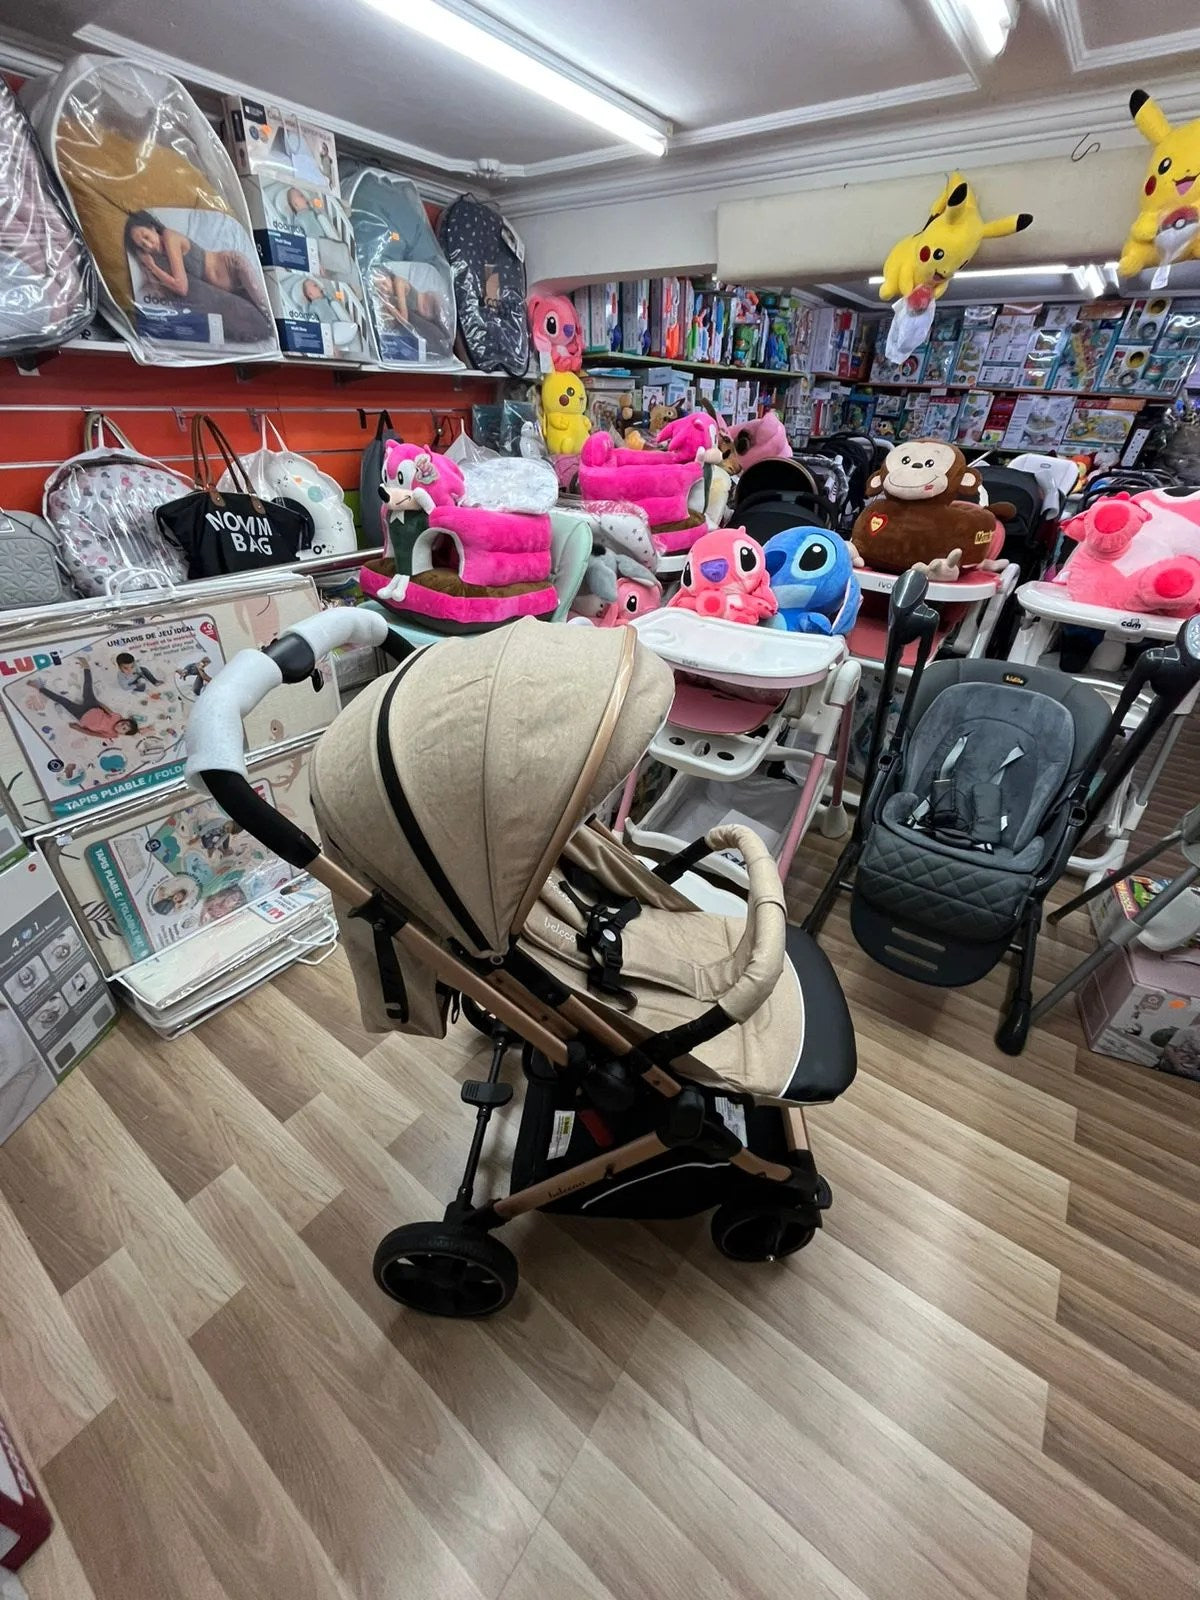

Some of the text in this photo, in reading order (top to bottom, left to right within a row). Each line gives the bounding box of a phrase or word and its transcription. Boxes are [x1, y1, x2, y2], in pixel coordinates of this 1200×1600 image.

[231, 532, 273, 556] BAG
[106, 639, 120, 648] UN
[120, 634, 144, 645] TAPIS
[145, 631, 157, 640] DE
[158, 627, 173, 638] JEU
[64, 793, 99, 810] TAPIS
[100, 776, 147, 800] PLIABLE
[95, 848, 109, 870] TAPIS
[104, 869, 123, 899] PLIABLE
